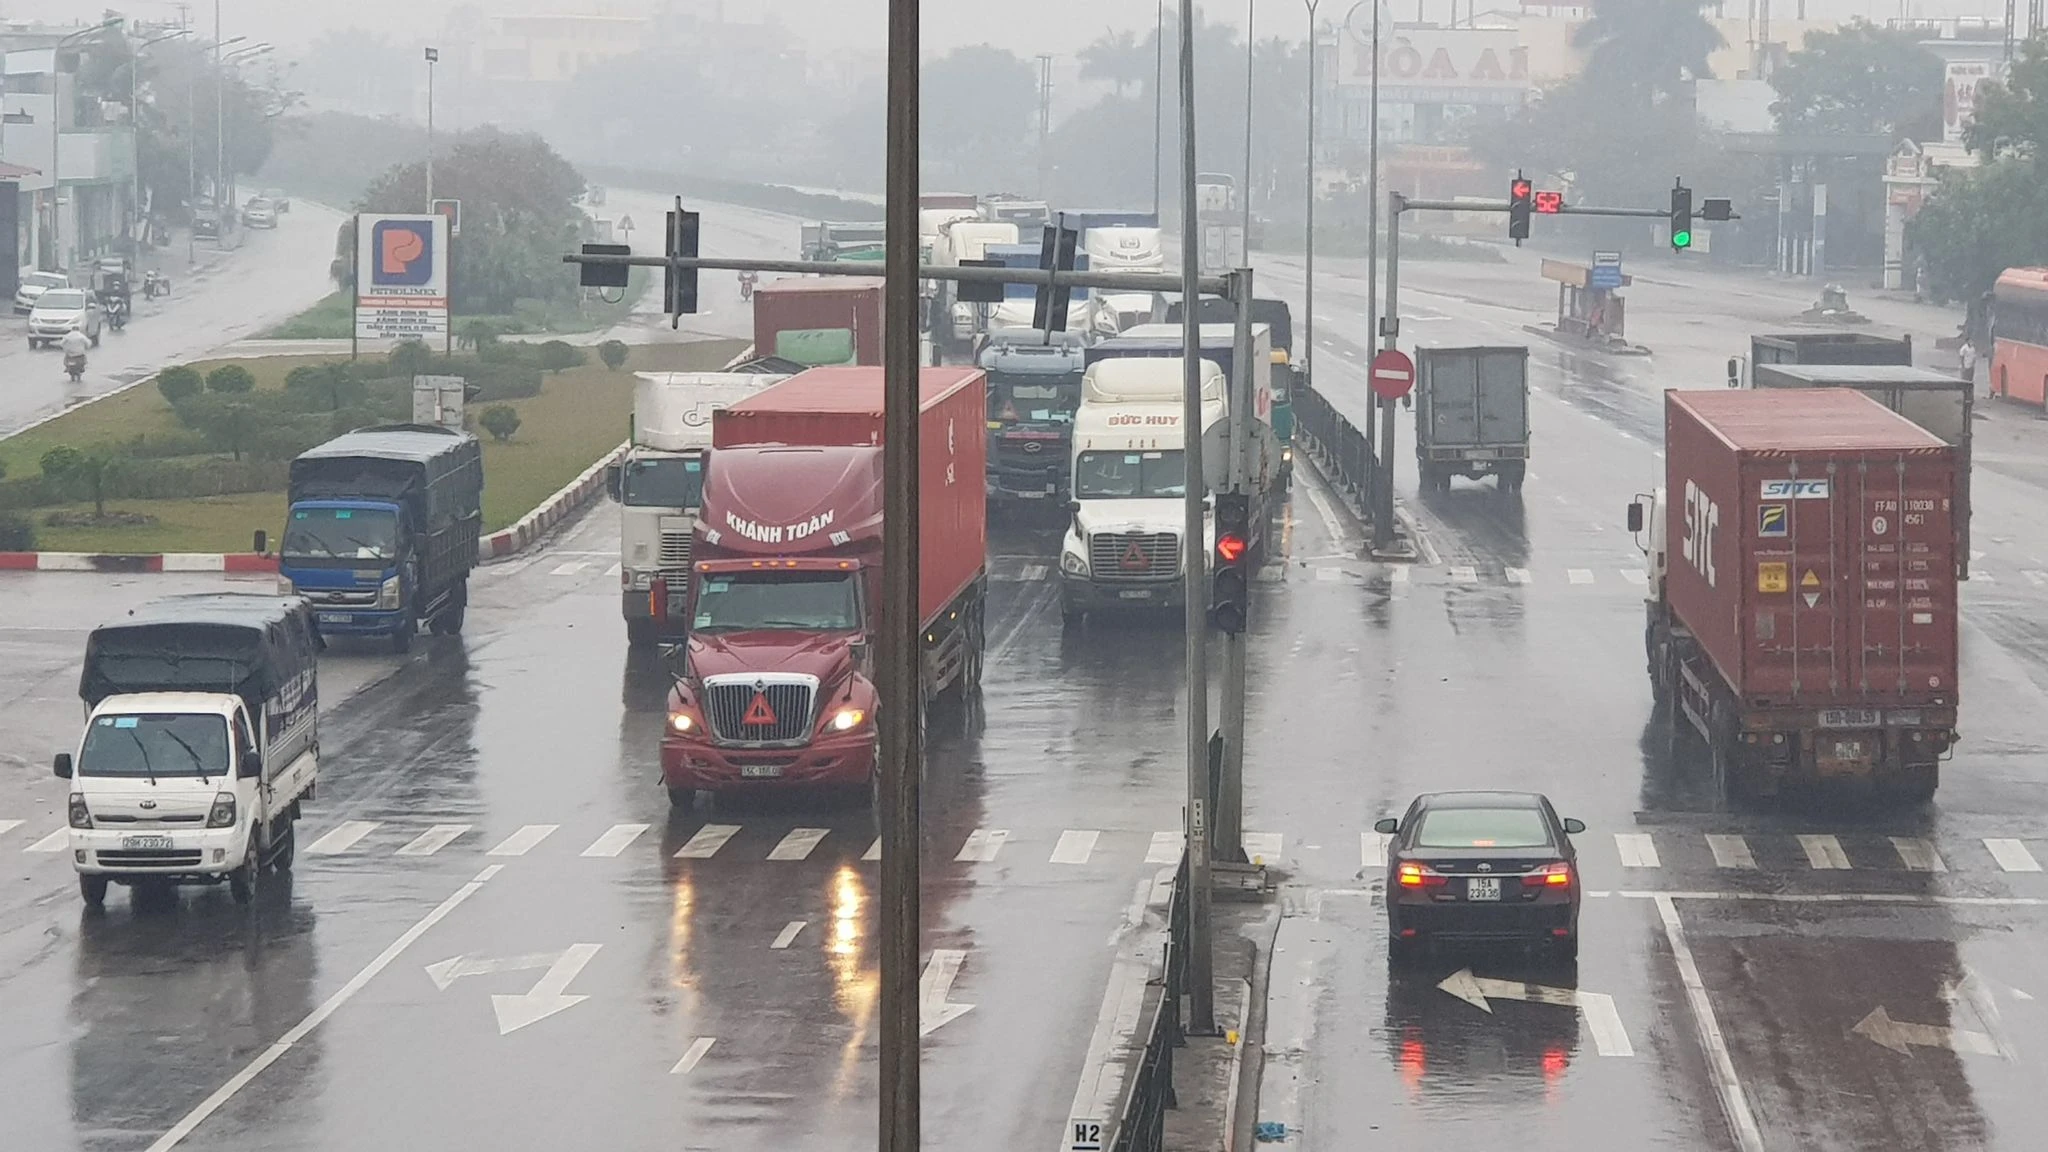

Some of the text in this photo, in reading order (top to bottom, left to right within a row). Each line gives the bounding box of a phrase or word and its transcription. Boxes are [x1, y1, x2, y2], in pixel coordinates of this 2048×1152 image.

[1536, 193, 1560, 213] 52
[369, 287, 437, 296] PETROLIMEX
[1145, 415, 1180, 426] HUY
[1763, 482, 1827, 495] SITC
[726, 509, 783, 544] KHÁNH
[786, 508, 836, 542] TOÀN
[1683, 478, 1719, 588] SITC
[1477, 879, 1492, 888] 15A
[1075, 1124, 1100, 1142] H2
